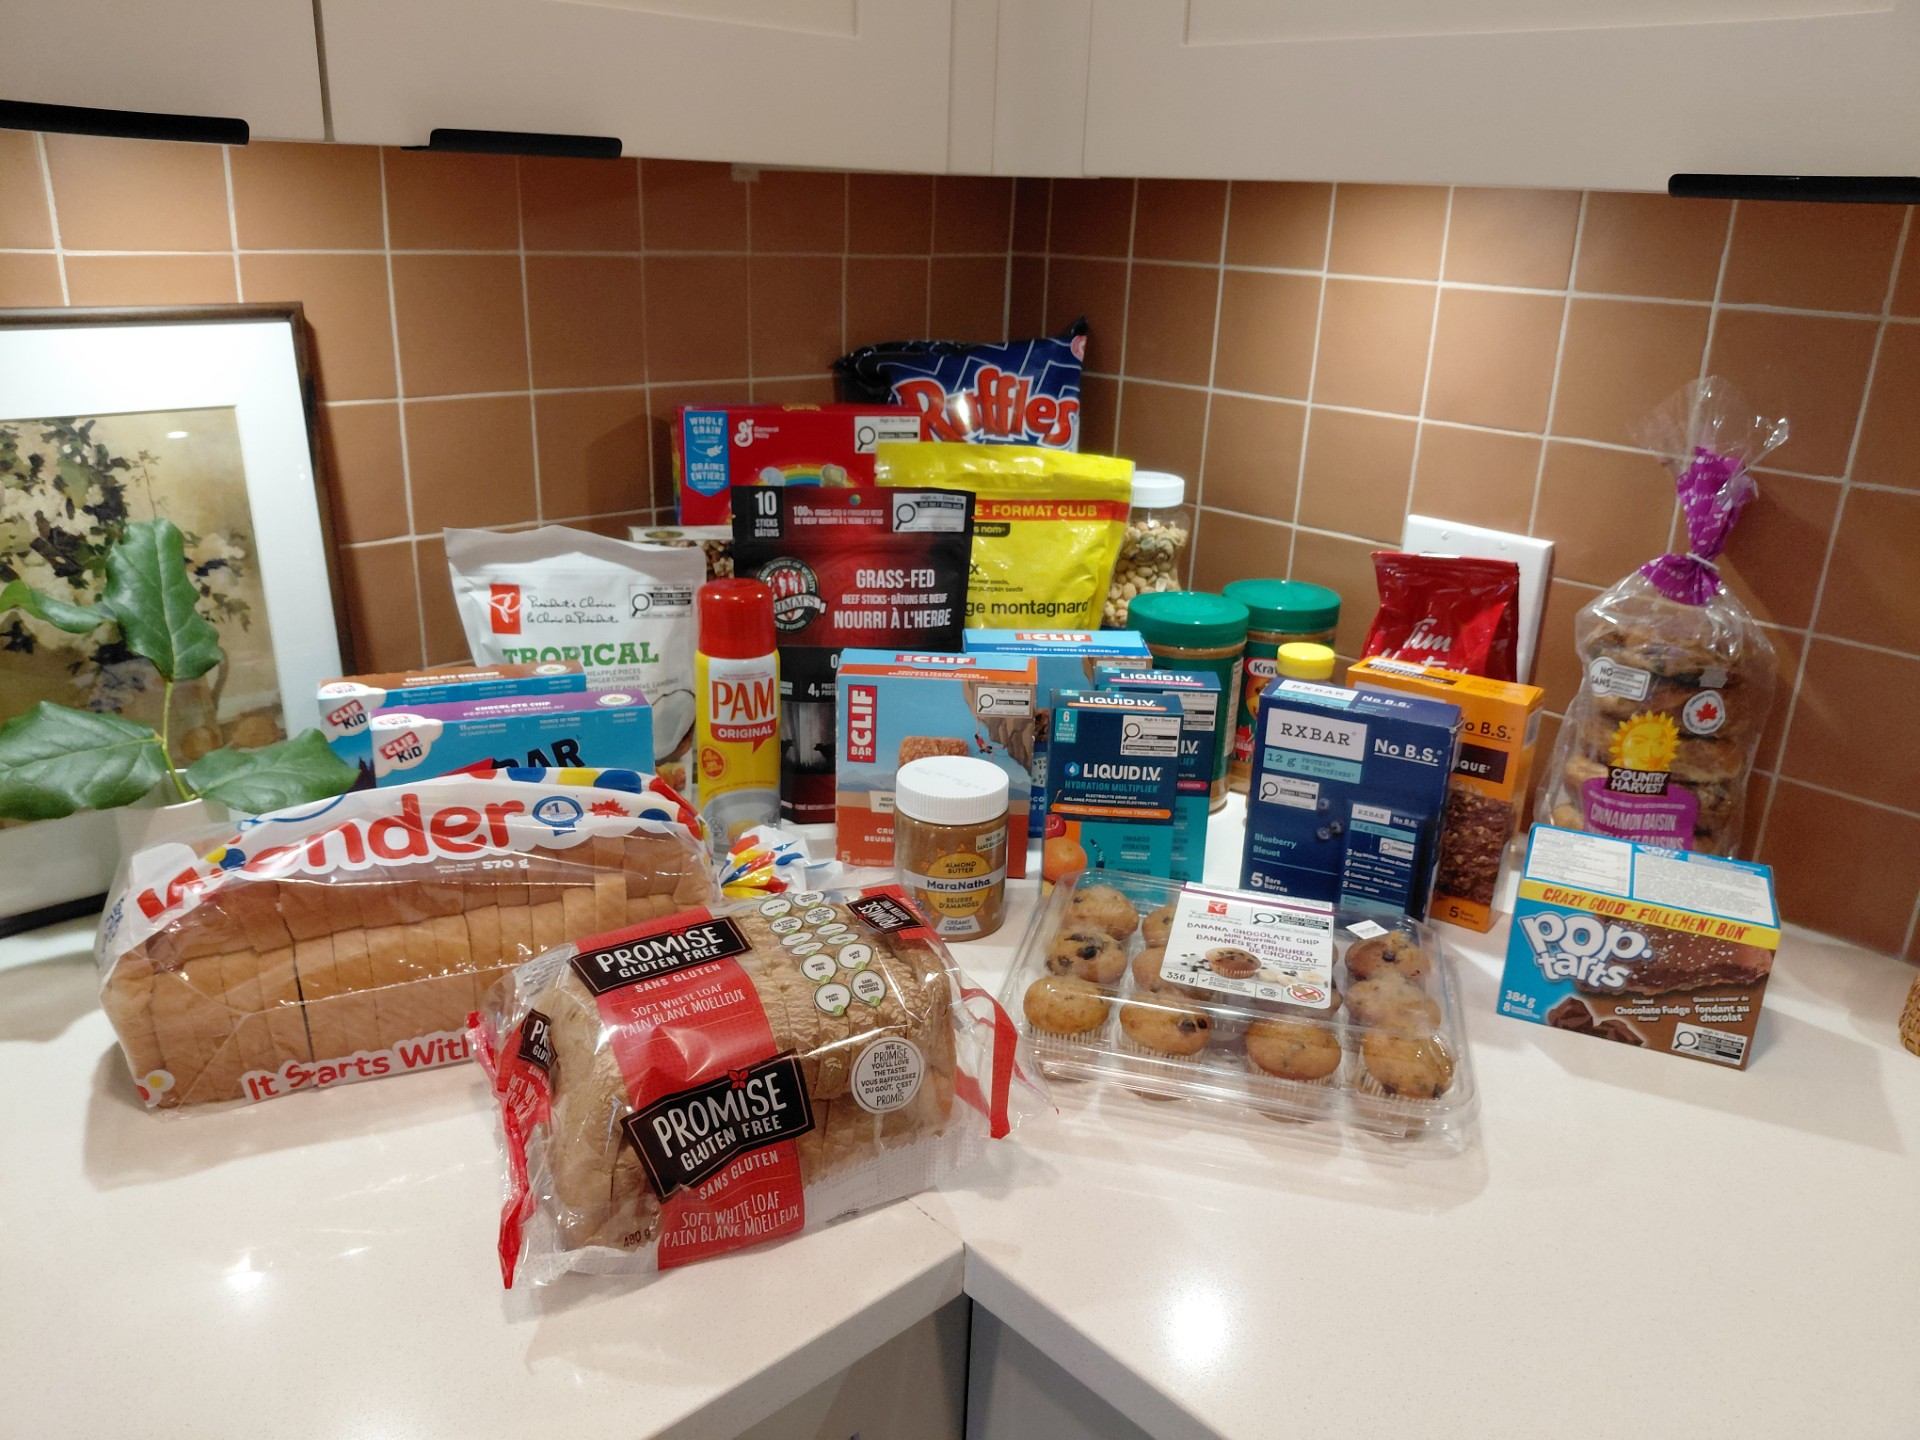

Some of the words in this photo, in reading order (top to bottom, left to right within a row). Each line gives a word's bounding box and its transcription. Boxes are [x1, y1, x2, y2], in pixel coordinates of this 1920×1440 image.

[892, 366, 1081, 447] Ruffles
[689, 415, 724, 427] WHOLE
[693, 425, 722, 436] GRAIN
[691, 462, 725, 472] GRAINS
[754, 490, 777, 517] 10
[992, 504, 1053, 517] FORMAT
[1057, 504, 1098, 517] CLUB
[755, 518, 778, 528] STICKS
[856, 569, 935, 588] GRASS-FED
[842, 594, 861, 605] BEEF
[834, 610, 887, 629] NOURRI
[890, 607, 901, 629] À
[903, 608, 953, 629] L'HERBE
[1031, 632, 1088, 642] CLIF
[1403, 617, 1453, 651] Tim
[502, 642, 660, 667] TROPICAL
[912, 655, 972, 665] CLIF
[1120, 672, 1174, 682] LIQUID
[1600, 665, 1614, 677] NO
[475, 702, 529, 712] CHOCOLATE
[529, 700, 551, 708] CHIP
[711, 678, 776, 721] PAM
[1079, 696, 1136, 706] LIQUID
[1360, 694, 1382, 705] No
[330, 700, 364, 725] CLIF
[851, 689, 874, 747] CLIF
[718, 725, 773, 739] ORIGINAL
[1480, 721, 1513, 741] B.S.
[383, 732, 420, 758] CLIF
[1280, 722, 1351, 747] RXBAR
[1374, 738, 1400, 756] No
[1404, 743, 1439, 764] B.S.
[850, 746, 873, 757] BAR
[1266, 752, 1283, 763] 12
[1286, 756, 1297, 769] g
[1083, 763, 1141, 781] LIQUID
[1141, 766, 1162, 782] I.V.
[1611, 768, 1668, 784] COUNTRY
[1064, 780, 1111, 792] HYDRATION
[1111, 781, 1159, 794] MULTIPLIER
[1610, 779, 1666, 795] HARVEST
[1590, 802, 1643, 831] CINNAMON
[1641, 812, 1678, 832] RAISIN
[1254, 832, 1297, 850] Blueberry
[841, 850, 850, 863] 5
[1252, 846, 1282, 858] Bleuet
[1346, 848, 1353, 856] 3
[481, 860, 515, 870] 570
[518, 858, 531, 869] g
[945, 860, 977, 868] ALMOND
[1345, 859, 1352, 868] 6
[1250, 871, 1263, 888] 5
[1264, 875, 1282, 886] Bars
[1343, 870, 1351, 878] 4
[927, 878, 992, 891] MaraNatha
[1264, 882, 1289, 894] barres
[1342, 880, 1349, 888] 2
[938, 901, 980, 909] D'AMANDES
[1448, 906, 1460, 918] 5
[1541, 887, 1587, 907] CRAZY
[1588, 897, 1628, 916] GOOD
[1636, 906, 1715, 932] FOLLEMENT
[1716, 921, 1747, 940] BON
[1186, 921, 1230, 934] BANANA
[1232, 927, 1294, 943] CHOCOLATE
[1295, 937, 1321, 947] CHIP
[1195, 933, 1246, 948] BANANES
[1245, 940, 1261, 949] ET
[1260, 943, 1314, 958] BRISURES
[619, 954, 680, 979] GLUTEN
[685, 944, 722, 963] FREE
[1262, 949, 1320, 965] CHOCOLAT
[634, 976, 670, 994] SANS
[672, 963, 722, 984] GLUTEN
[1166, 970, 1185, 982] 336
[1187, 976, 1196, 984] g
[630, 1003, 660, 1020] SOFT
[658, 992, 697, 1013] WHITE
[697, 983, 724, 998] LOAF
[1505, 990, 1527, 1004] 384
[1527, 996, 1537, 1009] g
[620, 1018, 653, 1039] PAIN
[653, 1008, 690, 1028] BLANC
[691, 988, 747, 1015] MOELLEUX
[1502, 1002, 1510, 1012] 8
[1614, 1006, 1661, 1015] Chocolate
[1662, 1005, 1692, 1017] Fudge
[1694, 1004, 1736, 1014] fondant
[1736, 1005, 1750, 1013] au
[1699, 1012, 1744, 1023] chocolat
[885, 1043, 895, 1051] WE
[874, 1048, 909, 1063] PROMISE
[871, 1062, 894, 1071] YOU'LL
[894, 1058, 910, 1067] LOVE
[860, 1078, 878, 1088] VOUS
[879, 1072, 917, 1086] RAFFOLEREZ
[874, 1069, 887, 1078] THE
[247, 1075, 280, 1101] It
[865, 1086, 875, 1095] DU
[680, 1126, 738, 1173] GLUTEN
[740, 1113, 784, 1140] FREE
[699, 1174, 730, 1201] SANS
[730, 1149, 780, 1181] GLUTEN
[680, 1211, 712, 1230] SOFT
[713, 1200, 753, 1226] WHITE
[750, 1190, 782, 1216] LOAF
[663, 1225, 698, 1249] PAIN
[699, 1222, 744, 1244] BLANC
[743, 1203, 801, 1237] MOELLEUX
